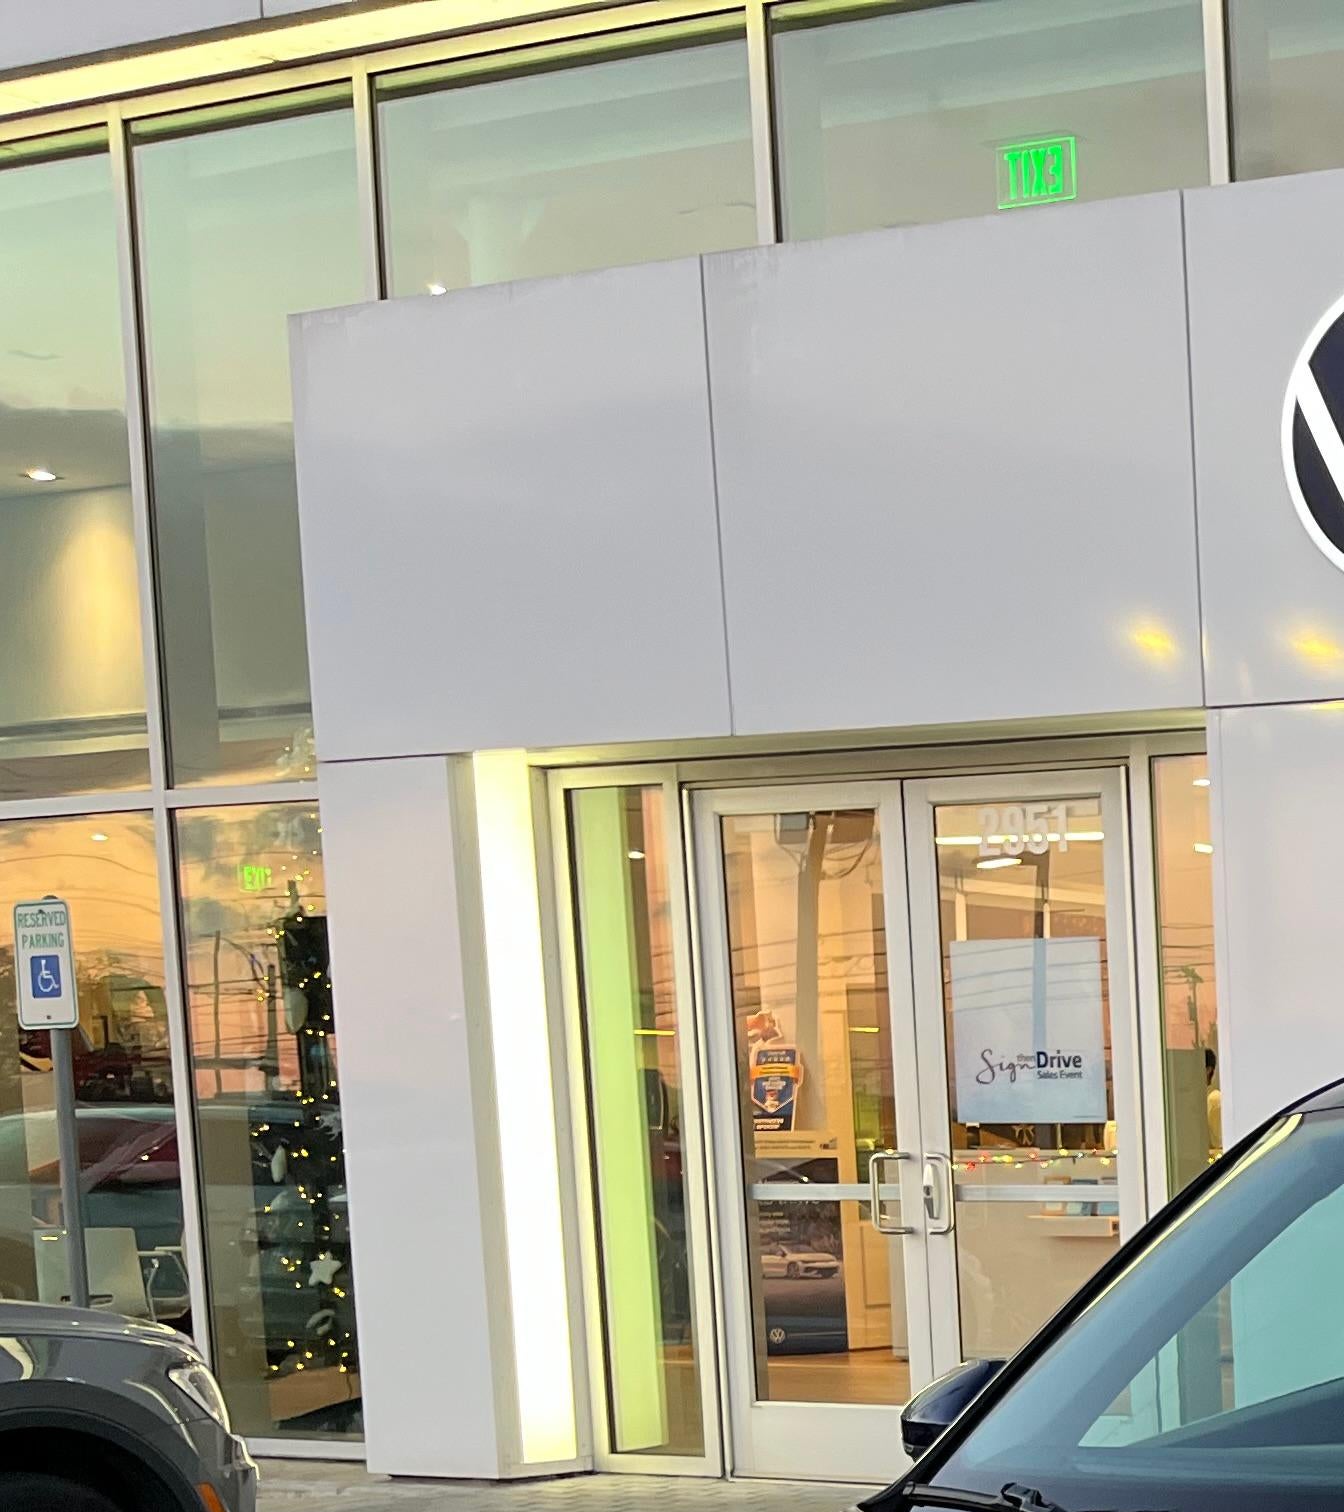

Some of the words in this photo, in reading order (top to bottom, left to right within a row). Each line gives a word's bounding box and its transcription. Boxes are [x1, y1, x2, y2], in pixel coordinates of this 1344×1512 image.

[977, 803, 1068, 856] 2951
[17, 911, 66, 928] RESERVED
[22, 932, 65, 949] PARKING
[1036, 1049, 1082, 1069] Drive
[1037, 1070, 1058, 1080] Sales
[1059, 1070, 1083, 1079] Event
